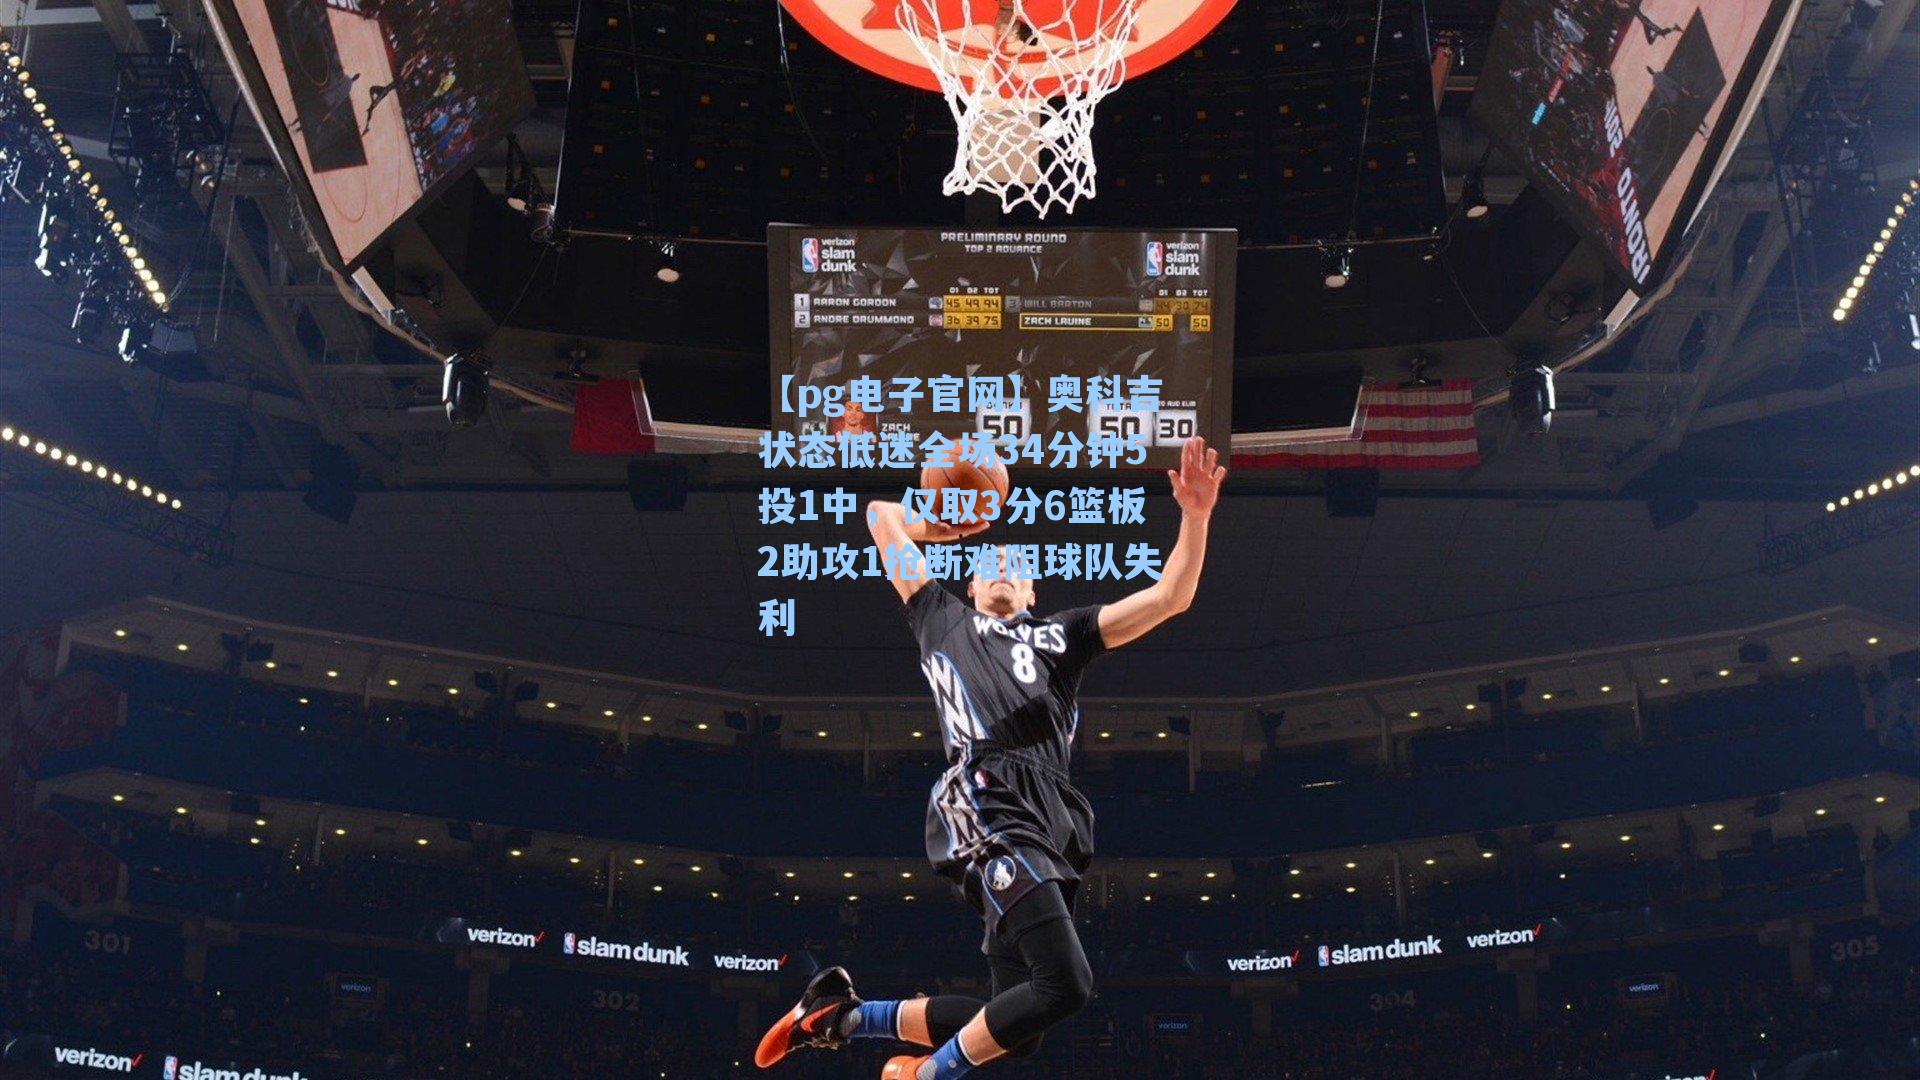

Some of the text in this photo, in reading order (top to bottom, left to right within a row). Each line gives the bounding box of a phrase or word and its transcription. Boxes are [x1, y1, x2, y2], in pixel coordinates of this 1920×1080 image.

[821, 237, 855, 246] verizon
[940, 232, 1067, 243] PRELIMINARY ROUND
[965, 244, 1043, 253] TOP 2 ADVANCE
[1166, 241, 1199, 250] verizon
[821, 246, 856, 259] slam
[1166, 250, 1199, 263] slam
[821, 260, 857, 272] dunk
[1165, 263, 1200, 275] dunk
[984, 286, 1000, 294] TOT
[813, 298, 850, 307] AARON
[853, 298, 896, 307] GORDON
[946, 299, 960, 308] 45
[966, 299, 980, 308] 49
[983, 299, 999, 308] 94
[1024, 300, 1048, 308] WILL
[1050, 300, 1092, 308] BARTON
[813, 315, 850, 323] ANDRE
[852, 315, 915, 324] DRUMMOND
[966, 316, 980, 325] 39
[985, 316, 999, 325] 75
[1024, 317, 1208, 328] ZACH LAVINE 50 50
[881, 423, 911, 432] ZACH
[983, 416, 1023, 440] 50
[1101, 416, 1140, 440] 50
[1160, 419, 1193, 438] 30
[973, 616, 1067, 653] WOLVES
[1011, 643, 1037, 684] 8
[84, 930, 131, 954] 301
[467, 927, 536, 948] verizon
[1466, 928, 1534, 949] verizon
[577, 936, 690, 967] slam dunk
[1331, 935, 1443, 965] slam dunk
[713, 954, 779, 972] verizon
[1227, 952, 1292, 972] verizon
[341, 982, 372, 993] verizon
[1629, 982, 1659, 993] verizon
[54, 1046, 132, 1072] verizon
